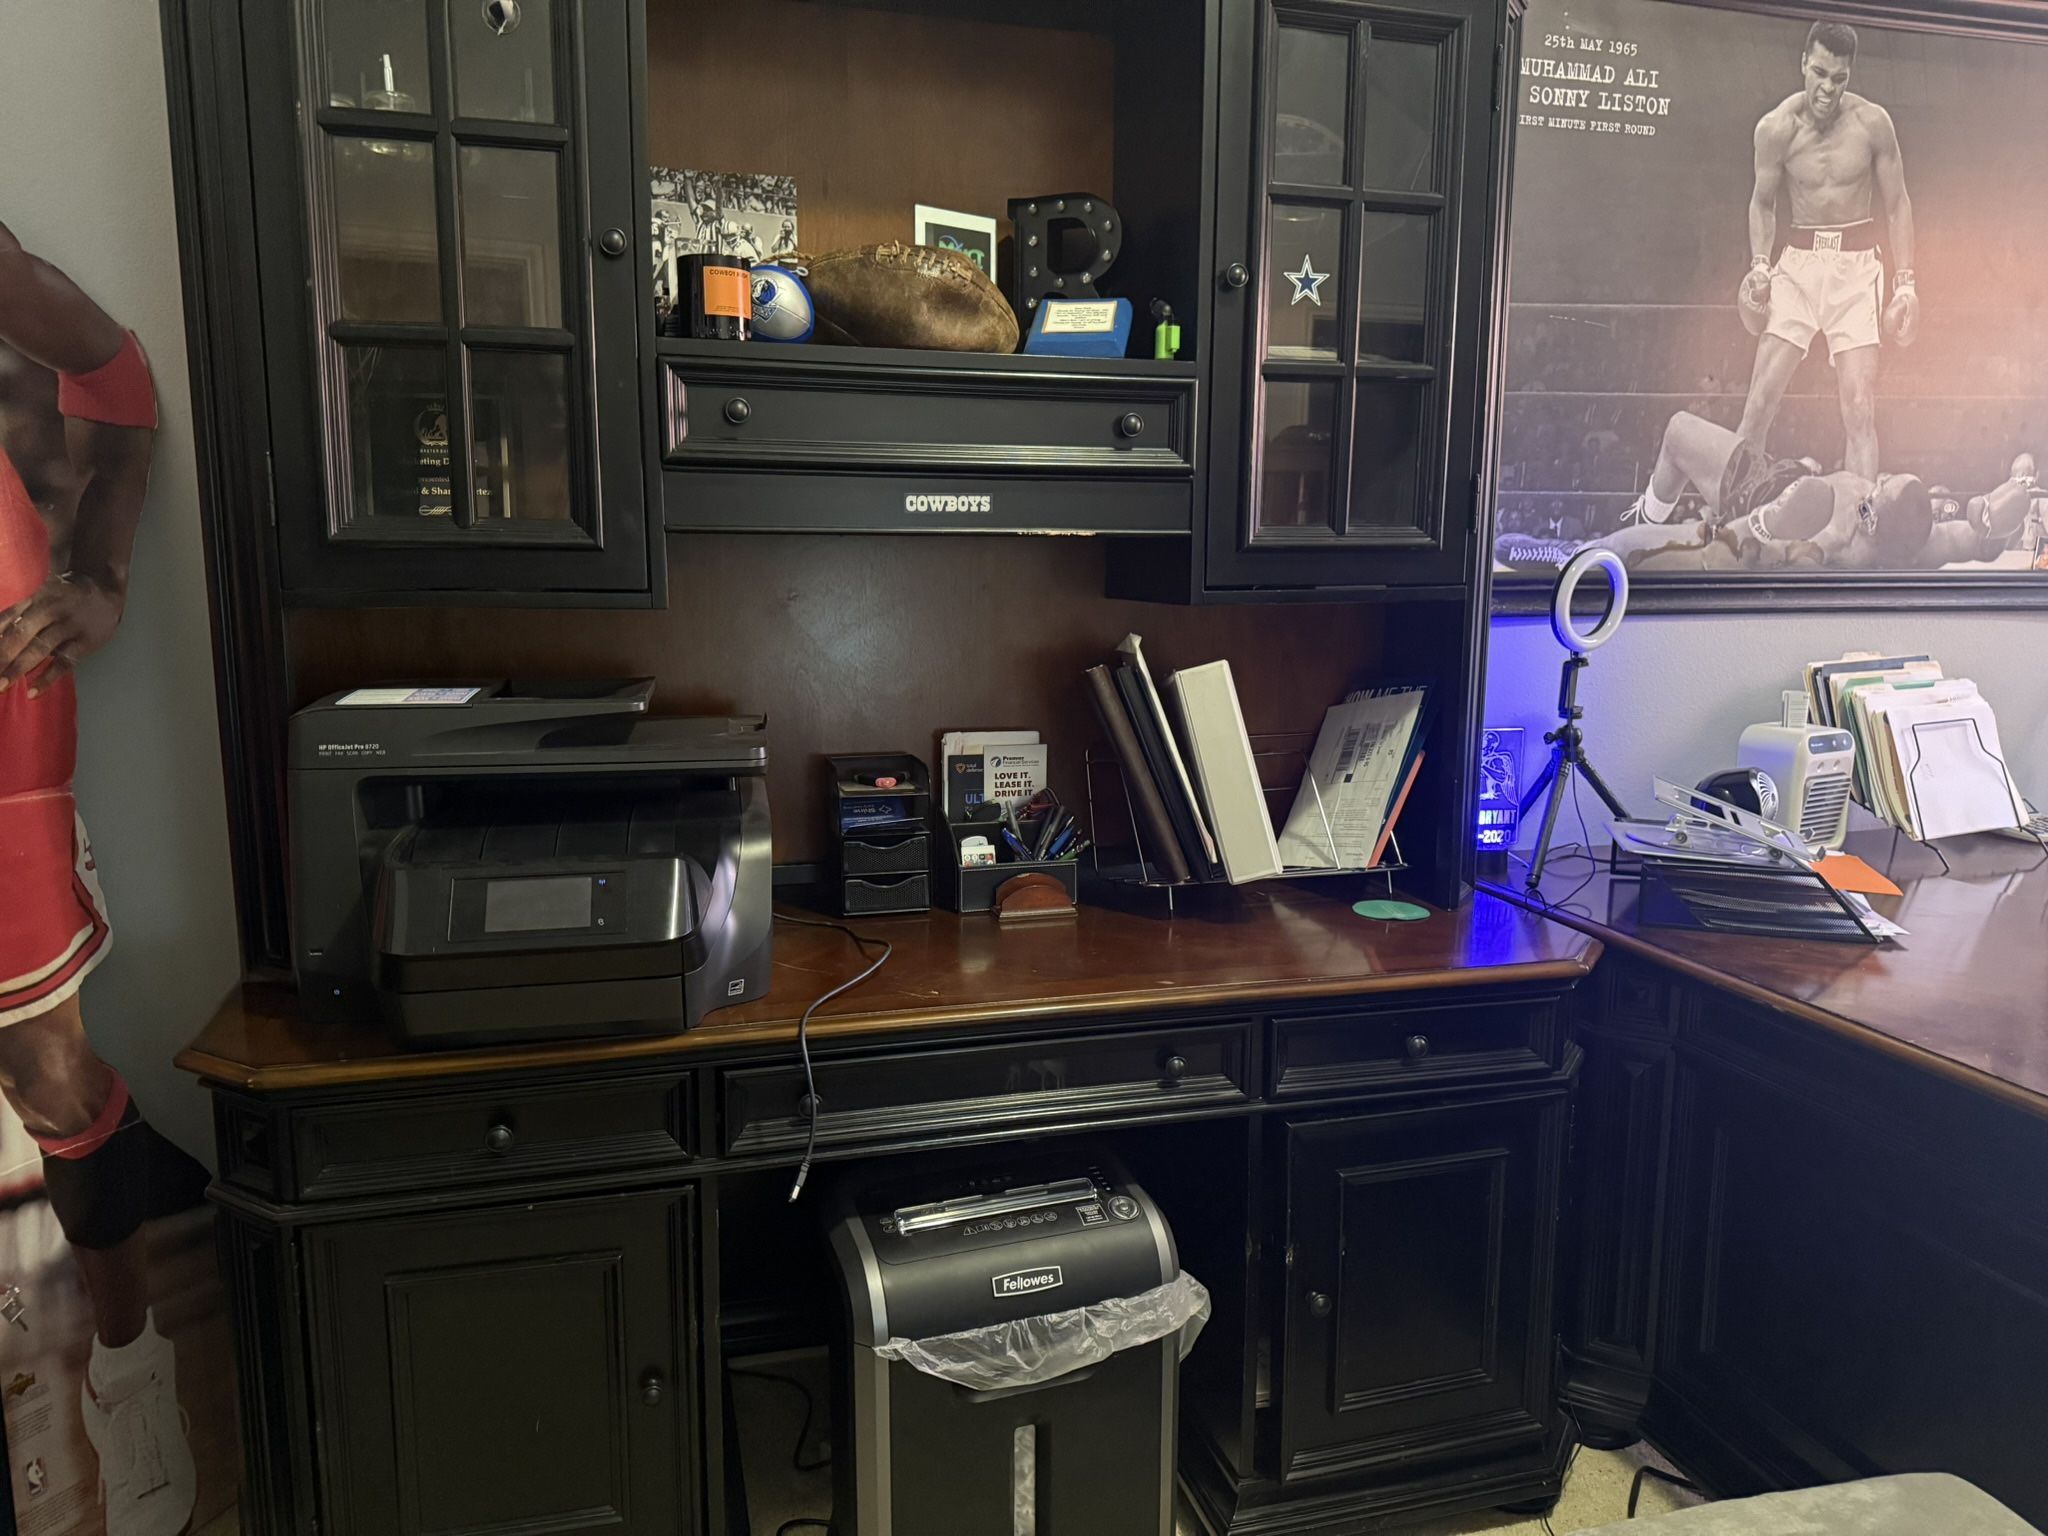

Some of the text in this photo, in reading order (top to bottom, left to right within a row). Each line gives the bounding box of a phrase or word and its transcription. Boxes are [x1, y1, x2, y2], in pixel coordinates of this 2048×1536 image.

[1544, 34, 1638, 57] 25th MAY 1965
[1520, 57, 1660, 88] MUHAMMAD ALI
[1529, 86, 1671, 116] SONNY LISTON
[1519, 114, 1656, 136] IRST MINUTE FIRST ROUND
[905, 495, 991, 512] COWBOYS
[994, 771, 1031, 780] LOVE IT.
[994, 780, 1035, 789] LEASE IT.
[965, 793, 984, 805] ULT
[994, 789, 1023, 798] DRIVE
[1478, 809, 1517, 825] BRYANT
[1003, 1272, 1055, 1292] Fellowes
